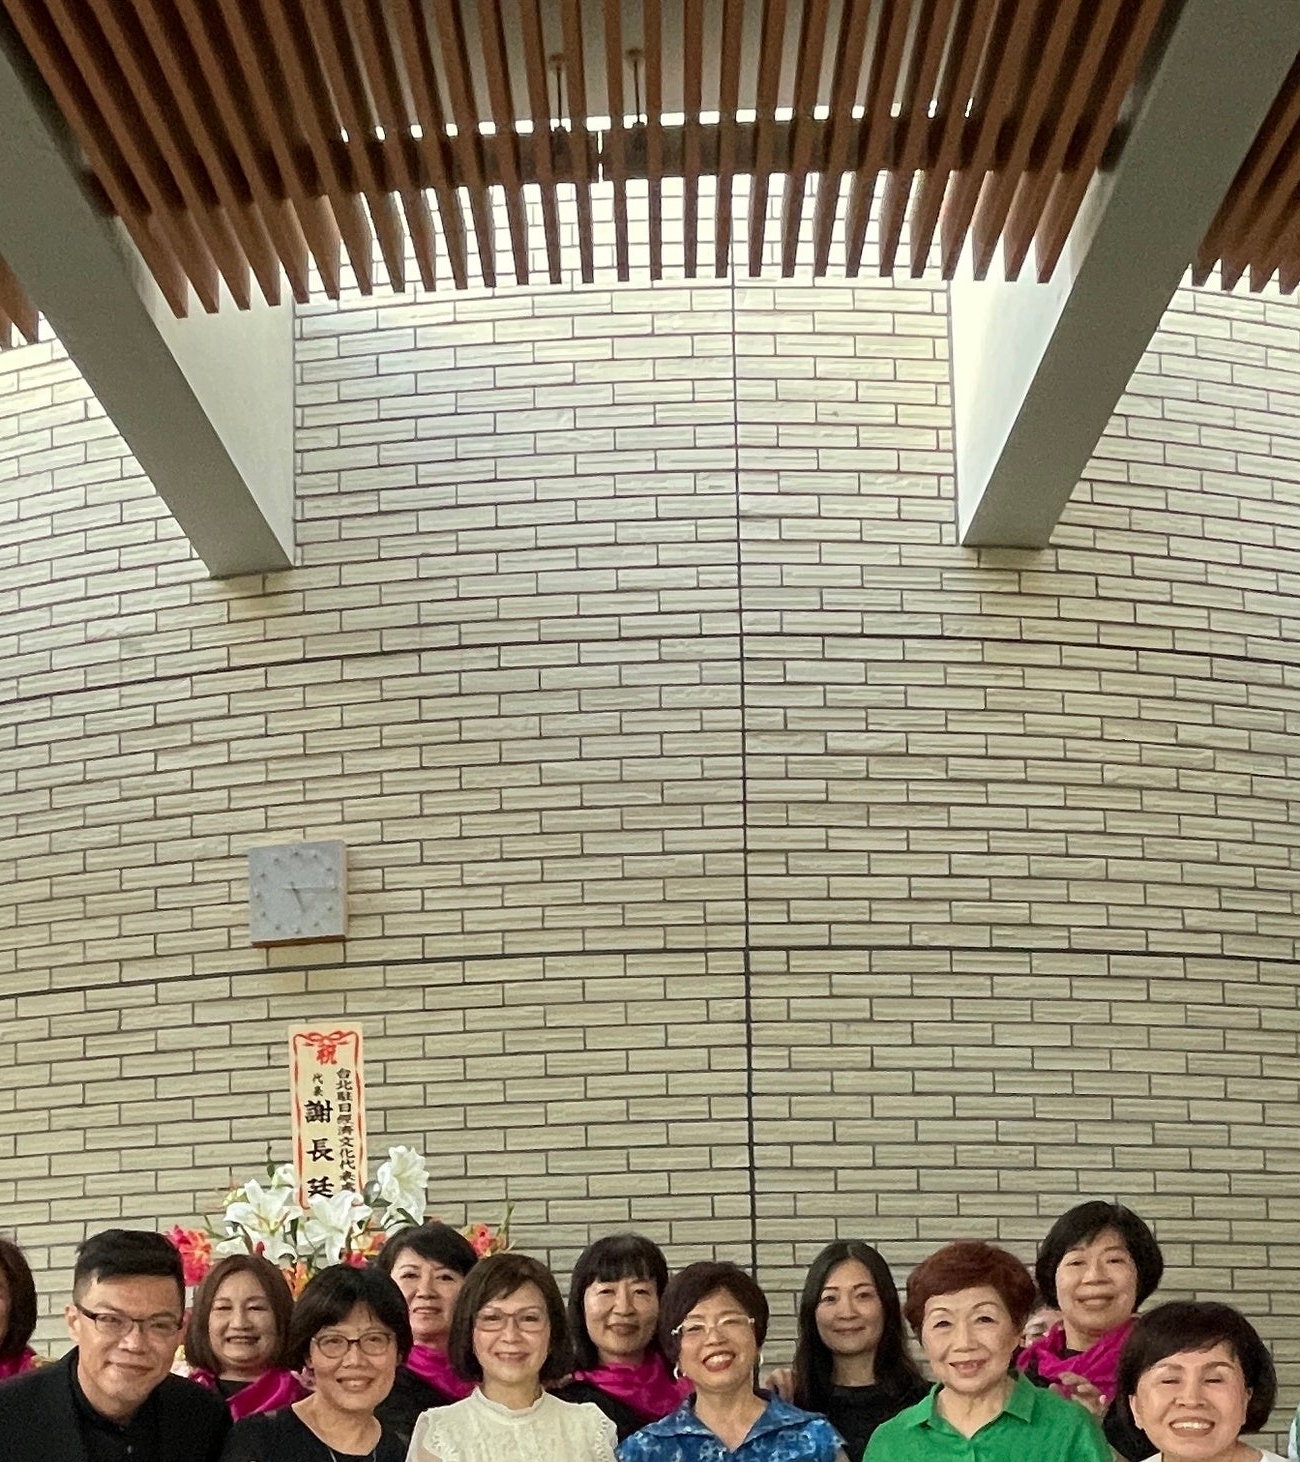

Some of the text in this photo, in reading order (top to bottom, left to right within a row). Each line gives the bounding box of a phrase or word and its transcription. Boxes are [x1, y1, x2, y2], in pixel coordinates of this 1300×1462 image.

[316, 1043, 338, 1065] 祝
[304, 1099, 335, 1199] 謝長廷
